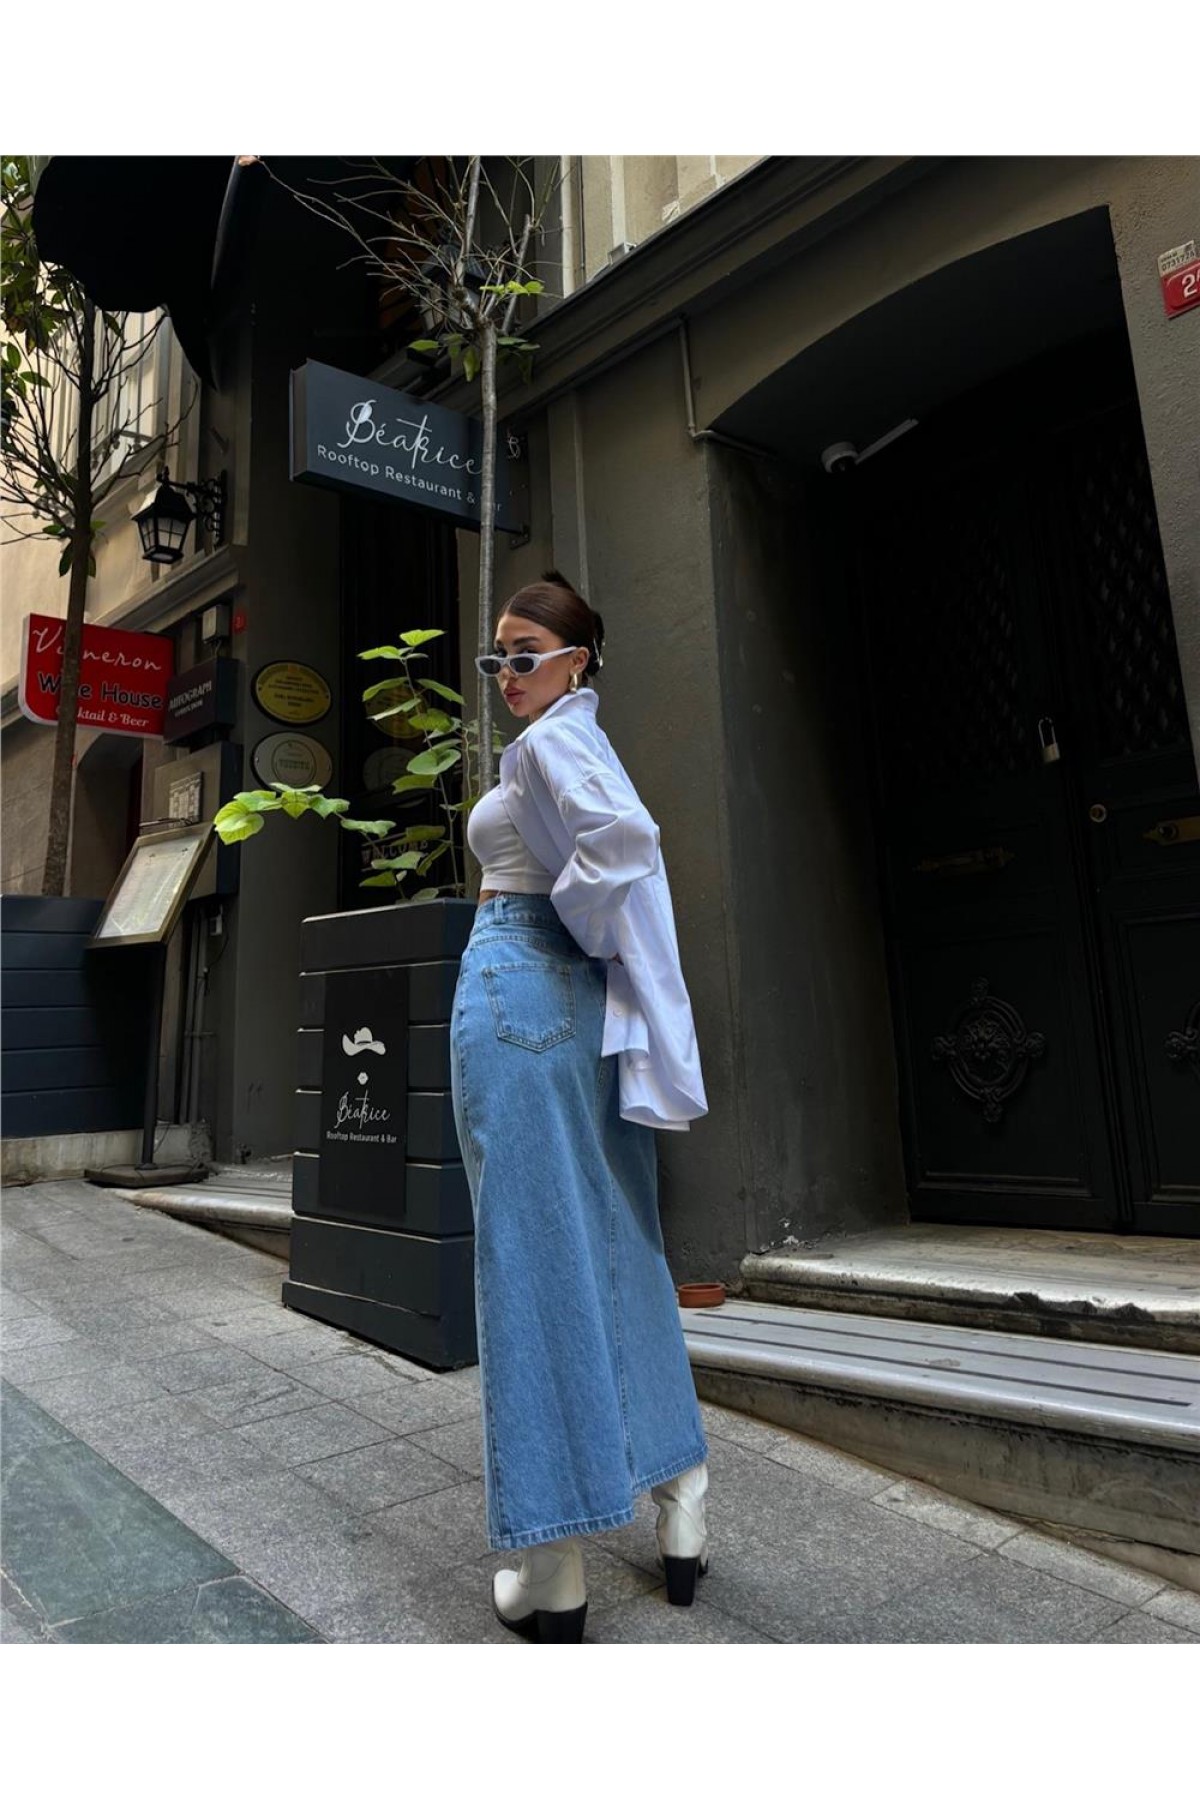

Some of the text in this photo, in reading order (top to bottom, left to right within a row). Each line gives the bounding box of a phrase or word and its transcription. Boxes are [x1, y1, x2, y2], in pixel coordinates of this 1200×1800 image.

[317, 444, 476, 504] Rooftop Restaurant &
[32, 626, 162, 672] Vineron
[37, 670, 92, 699] We
[101, 680, 163, 710] House
[108, 709, 119, 722] &
[119, 712, 150, 728] Beer
[326, 1130, 349, 1141] Rooftop
[349, 1132, 379, 1143] Restaurant
[386, 1134, 397, 1144] Bar
